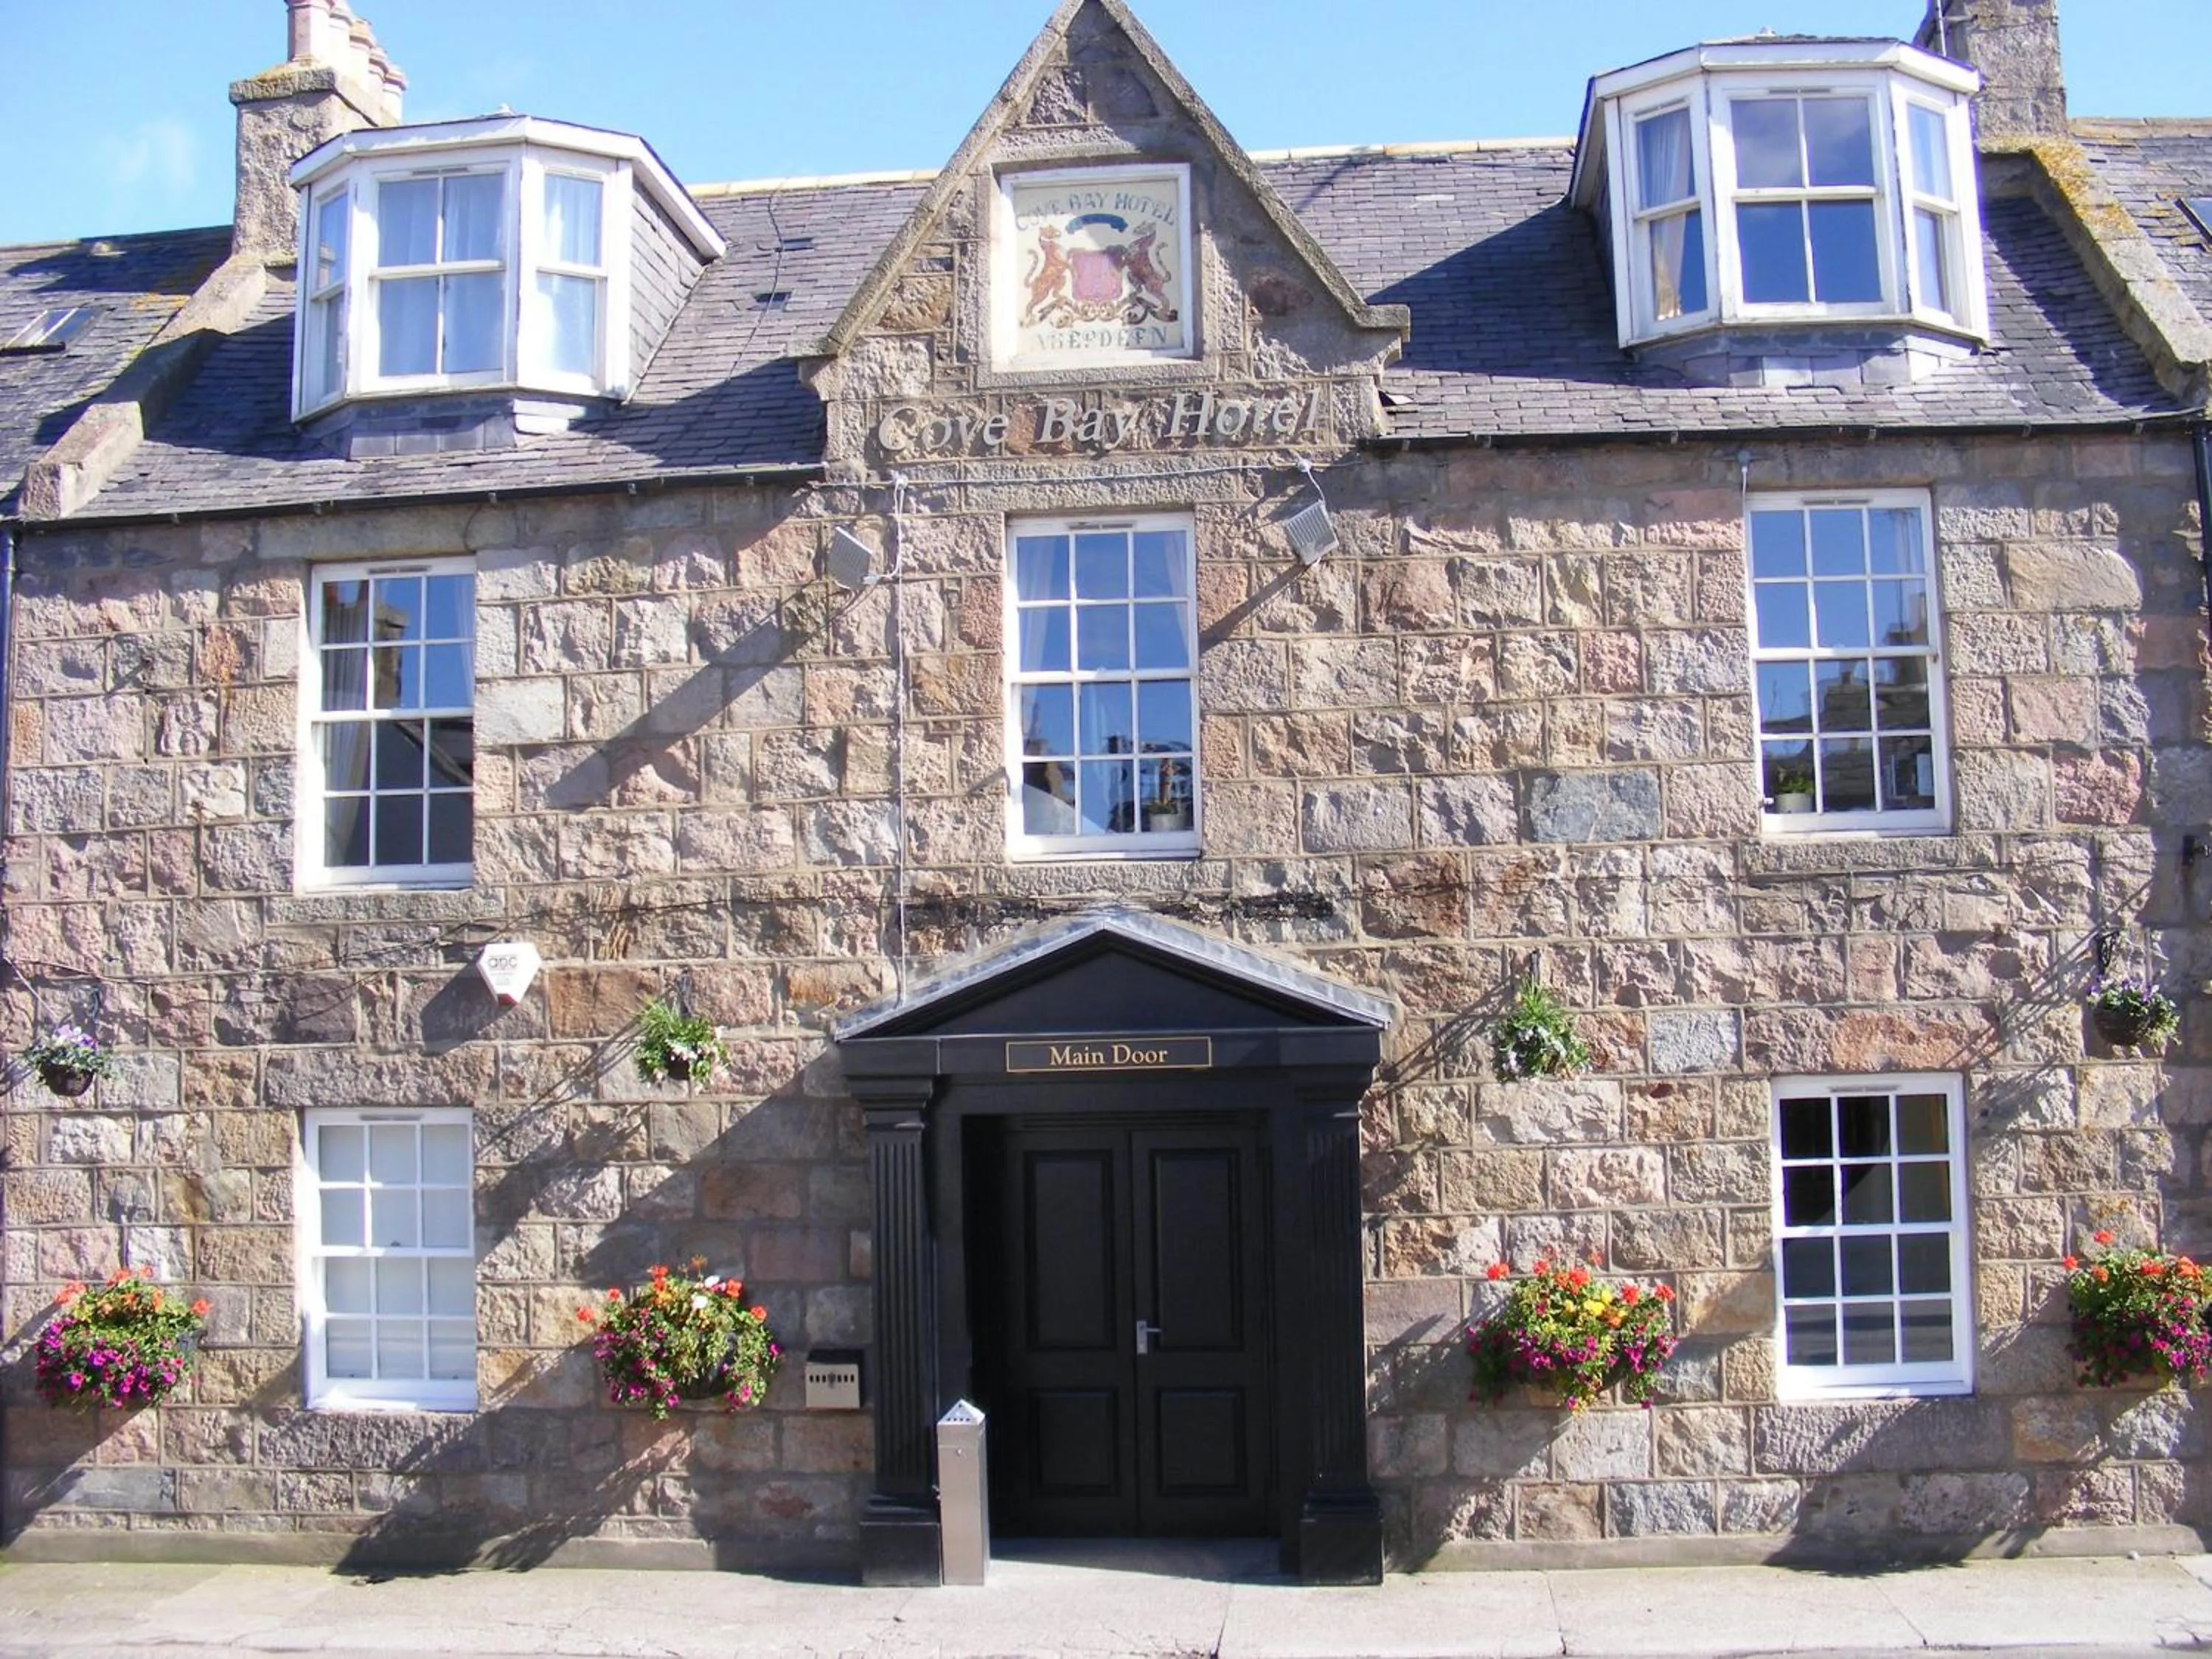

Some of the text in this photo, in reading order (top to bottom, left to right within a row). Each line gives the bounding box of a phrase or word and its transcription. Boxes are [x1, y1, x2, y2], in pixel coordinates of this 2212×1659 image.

[1069, 192, 1109, 211] BAY
[1115, 192, 1176, 226] HOTEL
[878, 389, 1320, 451] Cove Bay Hotel
[1049, 1044, 1168, 1065] Main Door
